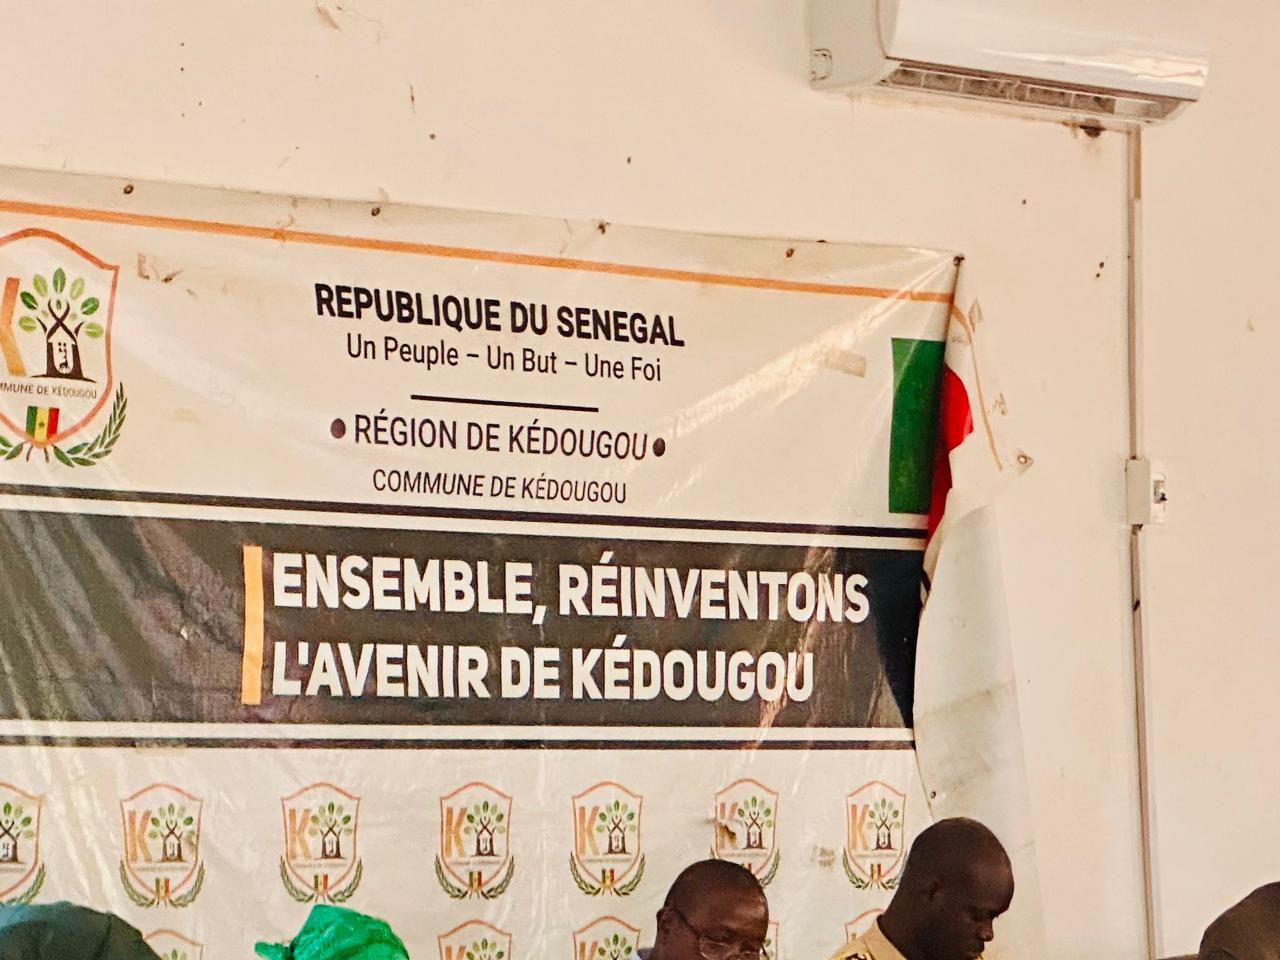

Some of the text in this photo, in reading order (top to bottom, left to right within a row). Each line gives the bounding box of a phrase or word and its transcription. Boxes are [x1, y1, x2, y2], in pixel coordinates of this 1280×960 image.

[315, 283, 685, 348] REPUBLIQUE DU SENEGAL
[347, 333, 376, 360] Un
[384, 336, 459, 371] Peuple
[487, 345, 515, 371] Un
[523, 348, 557, 375] But
[585, 353, 625, 380] Une
[632, 357, 661, 382] Foi
[355, 408, 648, 460] RÉGION DE KÉDOUGOU
[373, 469, 627, 503] COMMUNE DE KÉDOUGOU
[272, 551, 870, 625] ENSEMBLE, RÉINVENTONS
[272, 635, 815, 702] L'AVENIR DE KÉDOUGOU
